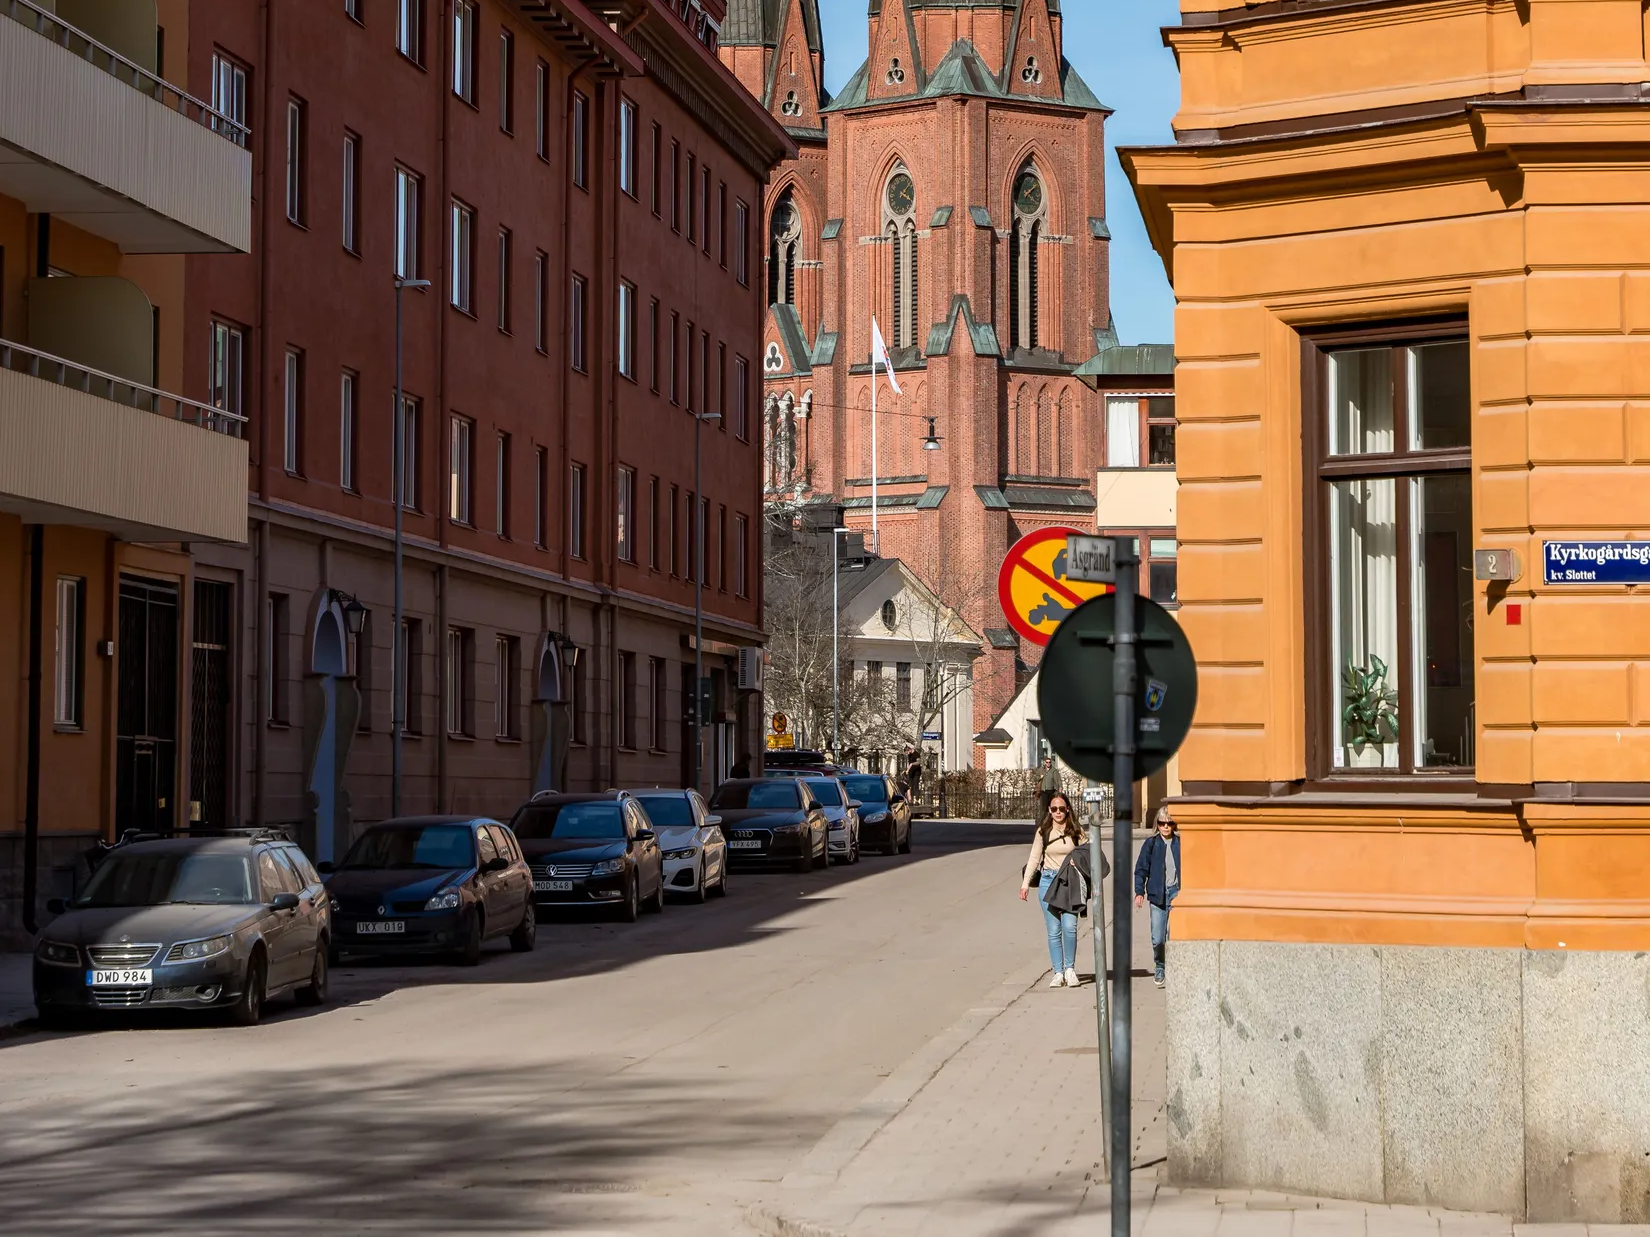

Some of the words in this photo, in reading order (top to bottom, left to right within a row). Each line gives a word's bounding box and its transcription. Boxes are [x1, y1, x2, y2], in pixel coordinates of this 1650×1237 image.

[1550, 544, 1650, 565] Kyrkogårdsg
[1488, 554, 1497, 574] 2
[1551, 569, 1564, 580] kv.
[1566, 569, 1596, 580] Slottet
[535, 881, 551, 890] MOD
[553, 881, 569, 890] 548
[358, 922, 377, 932] UKX
[96, 972, 119, 983] DWD
[123, 971, 146, 982] 984
